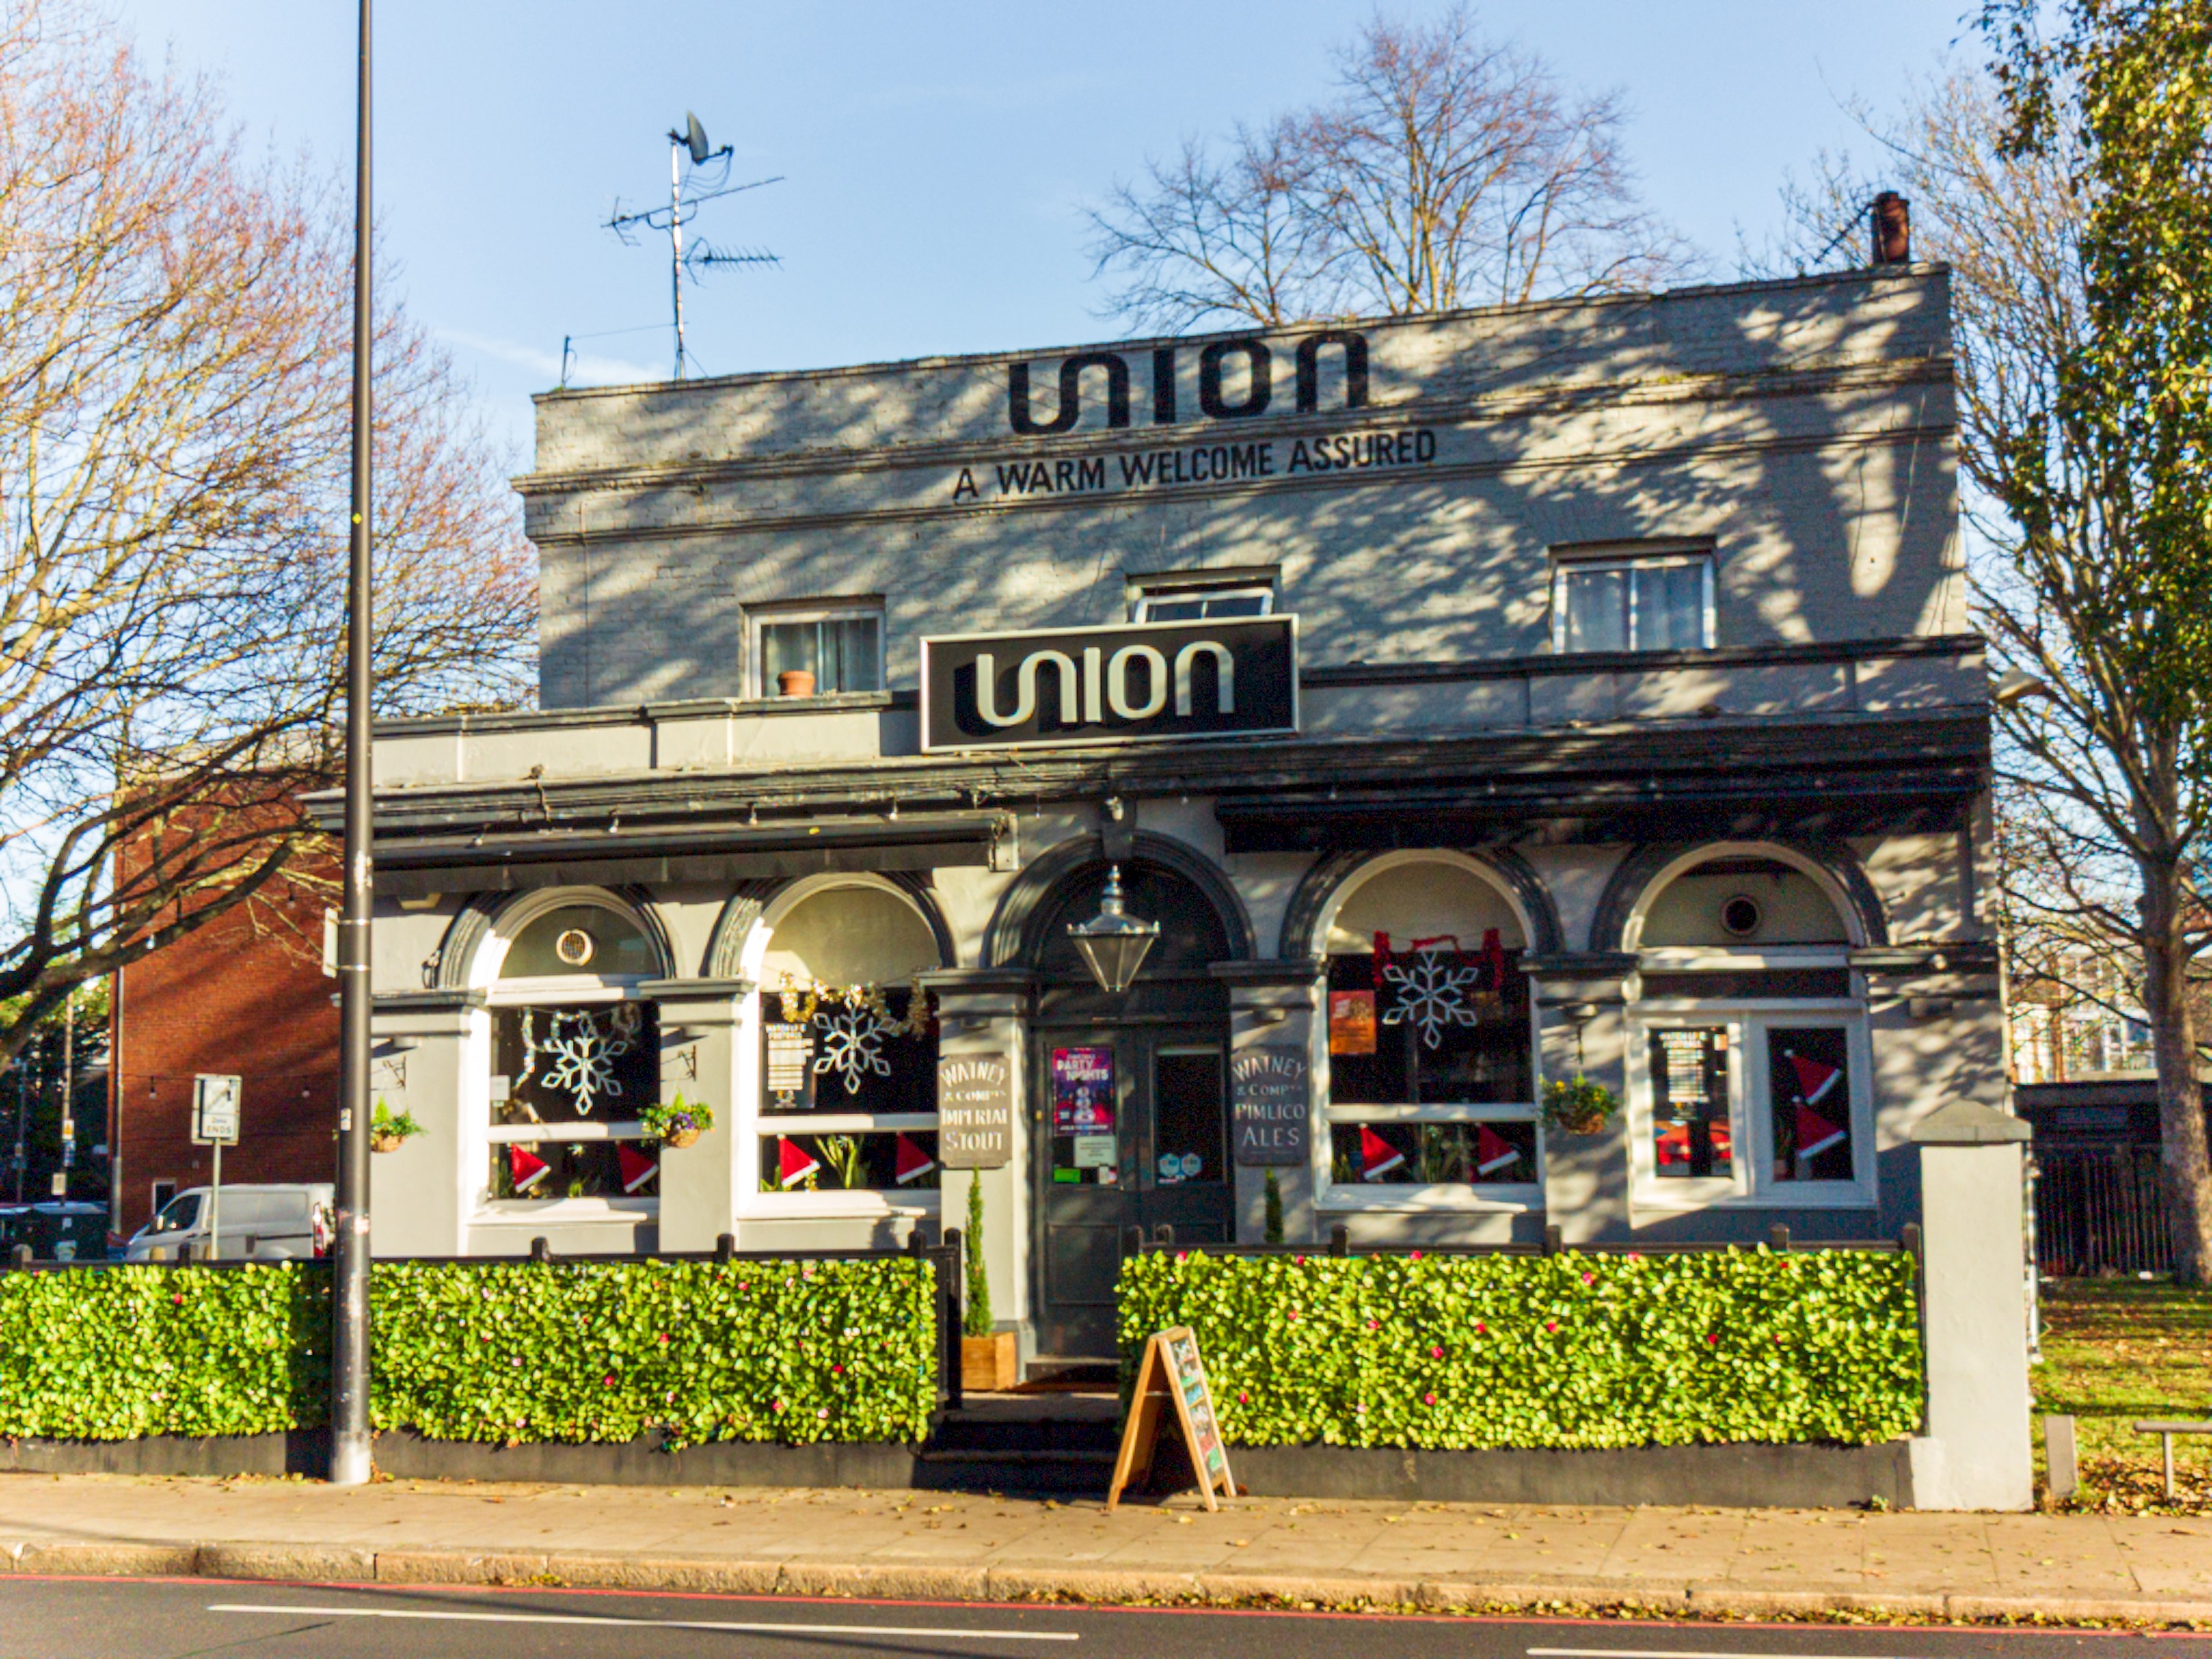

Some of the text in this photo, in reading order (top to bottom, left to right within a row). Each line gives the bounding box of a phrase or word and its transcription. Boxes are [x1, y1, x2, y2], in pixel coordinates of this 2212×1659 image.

[952, 428, 1437, 500] A WARM WELCOME ASSURED
[939, 1061, 1008, 1087] WATNEY
[1056, 1059, 1093, 1071] PARTY
[1232, 1056, 1306, 1082] WATNEY
[941, 1107, 1007, 1126] IMPERIAL
[1234, 1103, 1305, 1120] PIMLICO
[207, 1125, 232, 1135] ENDS
[1242, 1126, 1300, 1147] ALES
[945, 1131, 1002, 1151] STOUT
